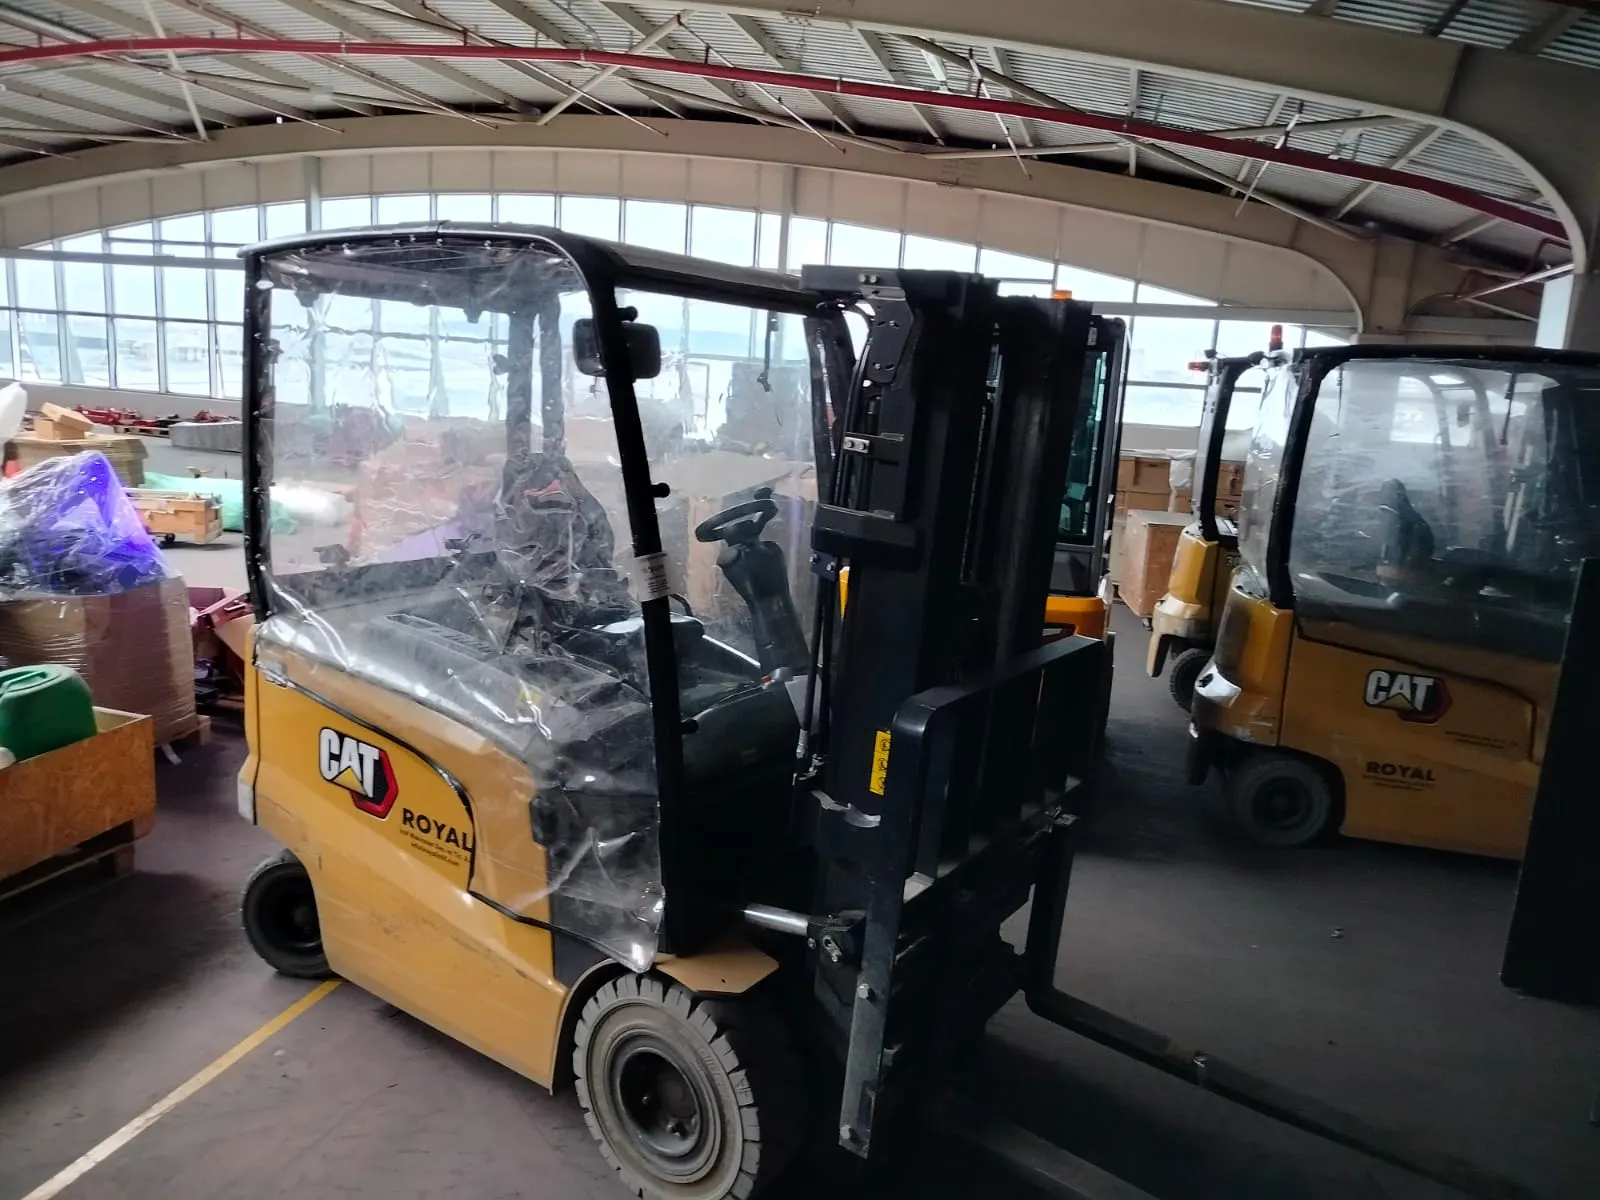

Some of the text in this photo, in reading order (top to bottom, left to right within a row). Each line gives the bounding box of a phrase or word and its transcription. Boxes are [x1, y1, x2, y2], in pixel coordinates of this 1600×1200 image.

[1365, 670, 1434, 712] CAT
[319, 727, 380, 799] CAT
[1366, 761, 1436, 782] ROYAL
[402, 807, 472, 853] ROYAL
